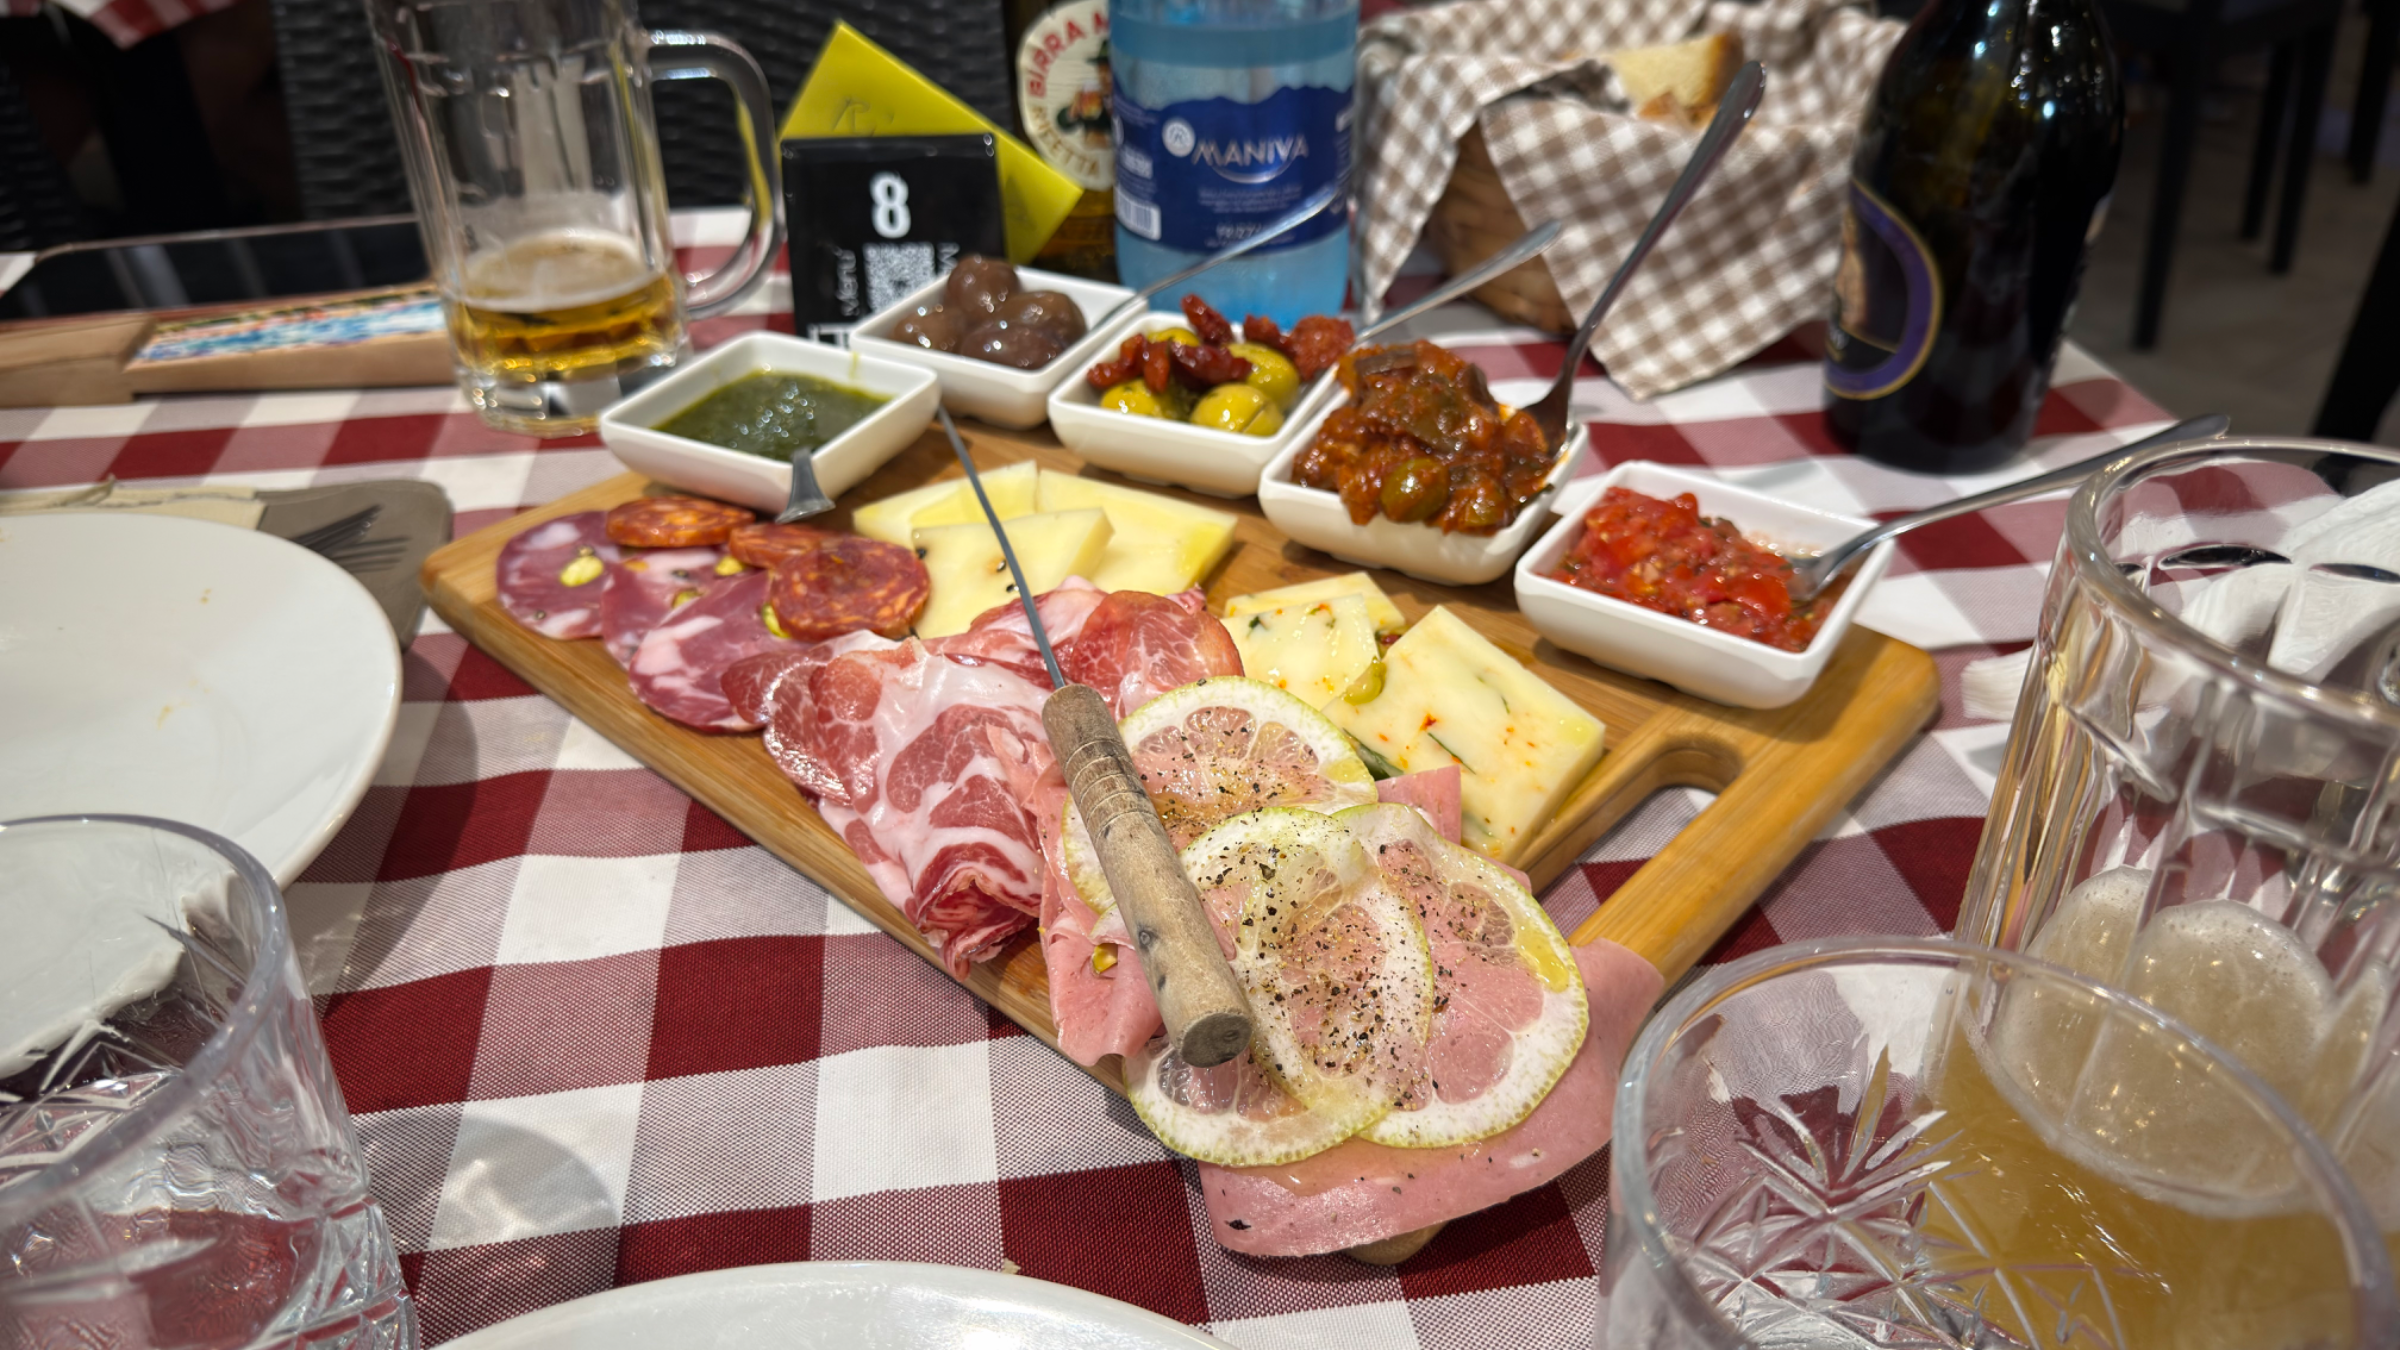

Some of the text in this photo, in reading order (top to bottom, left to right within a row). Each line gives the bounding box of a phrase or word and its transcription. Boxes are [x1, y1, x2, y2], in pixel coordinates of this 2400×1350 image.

[1028, 20, 1084, 98] BIRRA
[1191, 134, 1309, 166] MANIVA
[870, 171, 911, 239] 8
